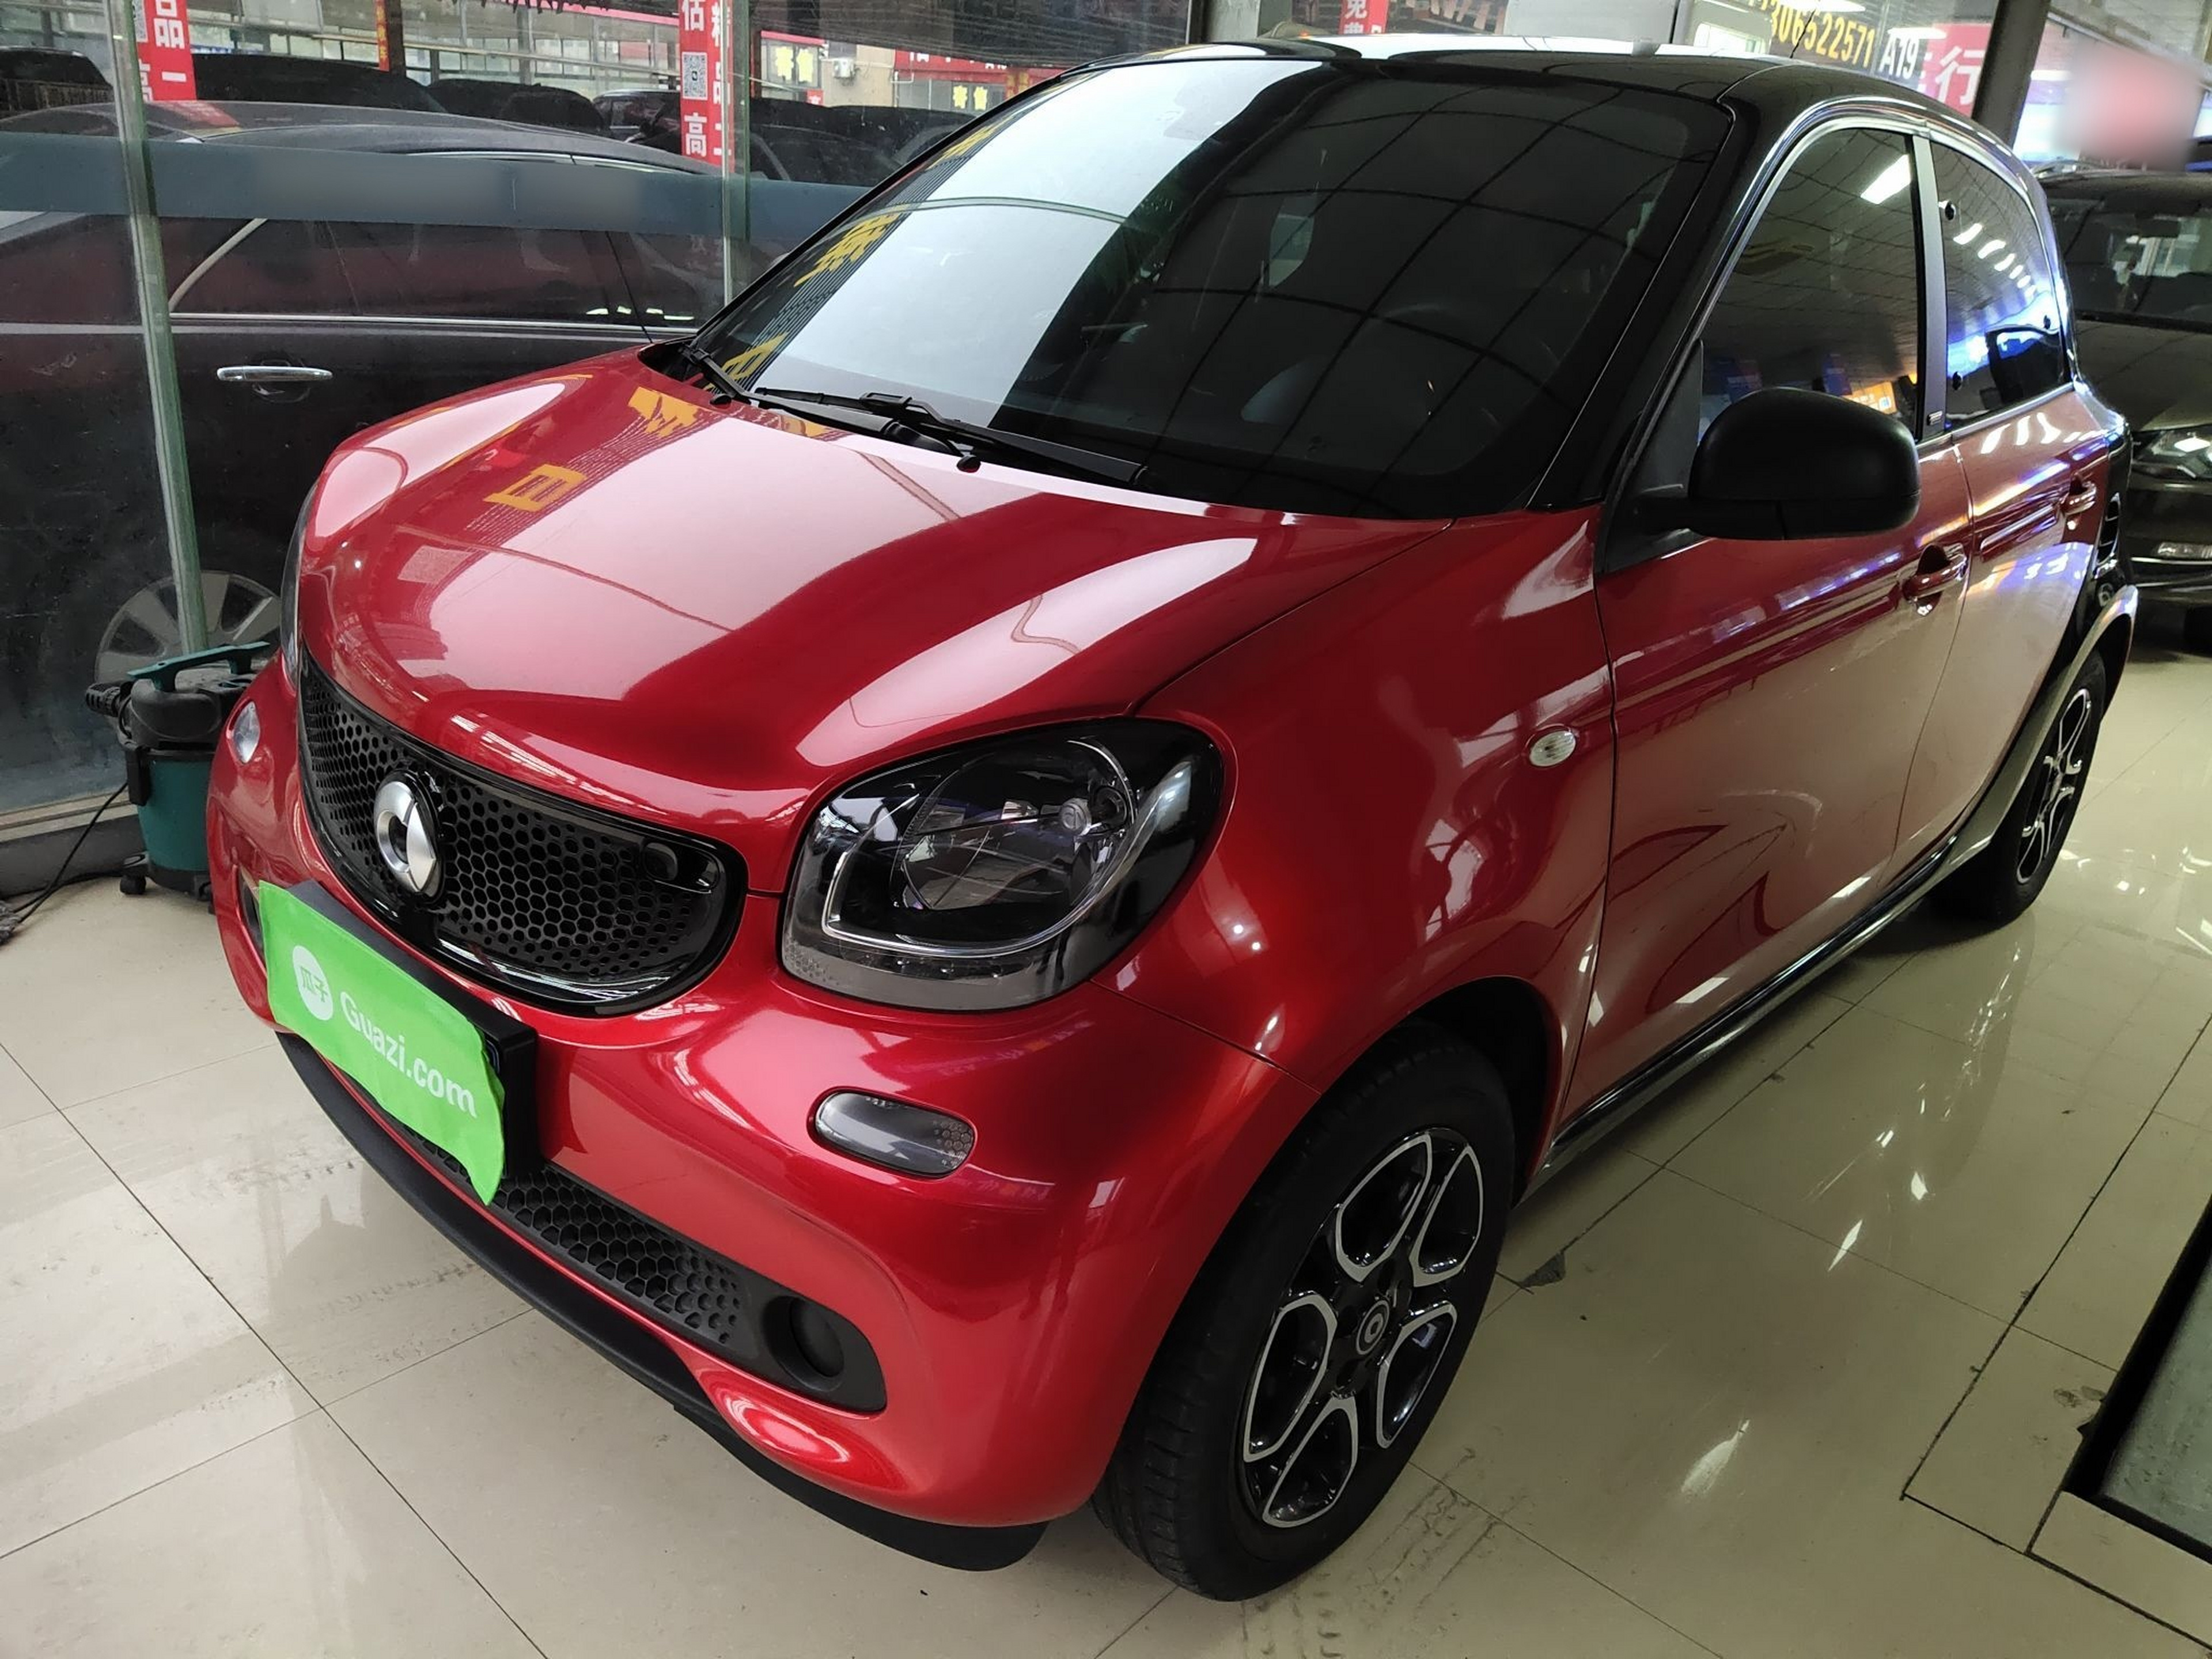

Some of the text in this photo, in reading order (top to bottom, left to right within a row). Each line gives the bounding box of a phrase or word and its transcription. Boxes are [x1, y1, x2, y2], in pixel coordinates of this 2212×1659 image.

[1916, 46, 1986, 105] 行
[684, 112, 707, 157] 高
[340, 991, 478, 1119] Guazi.com
